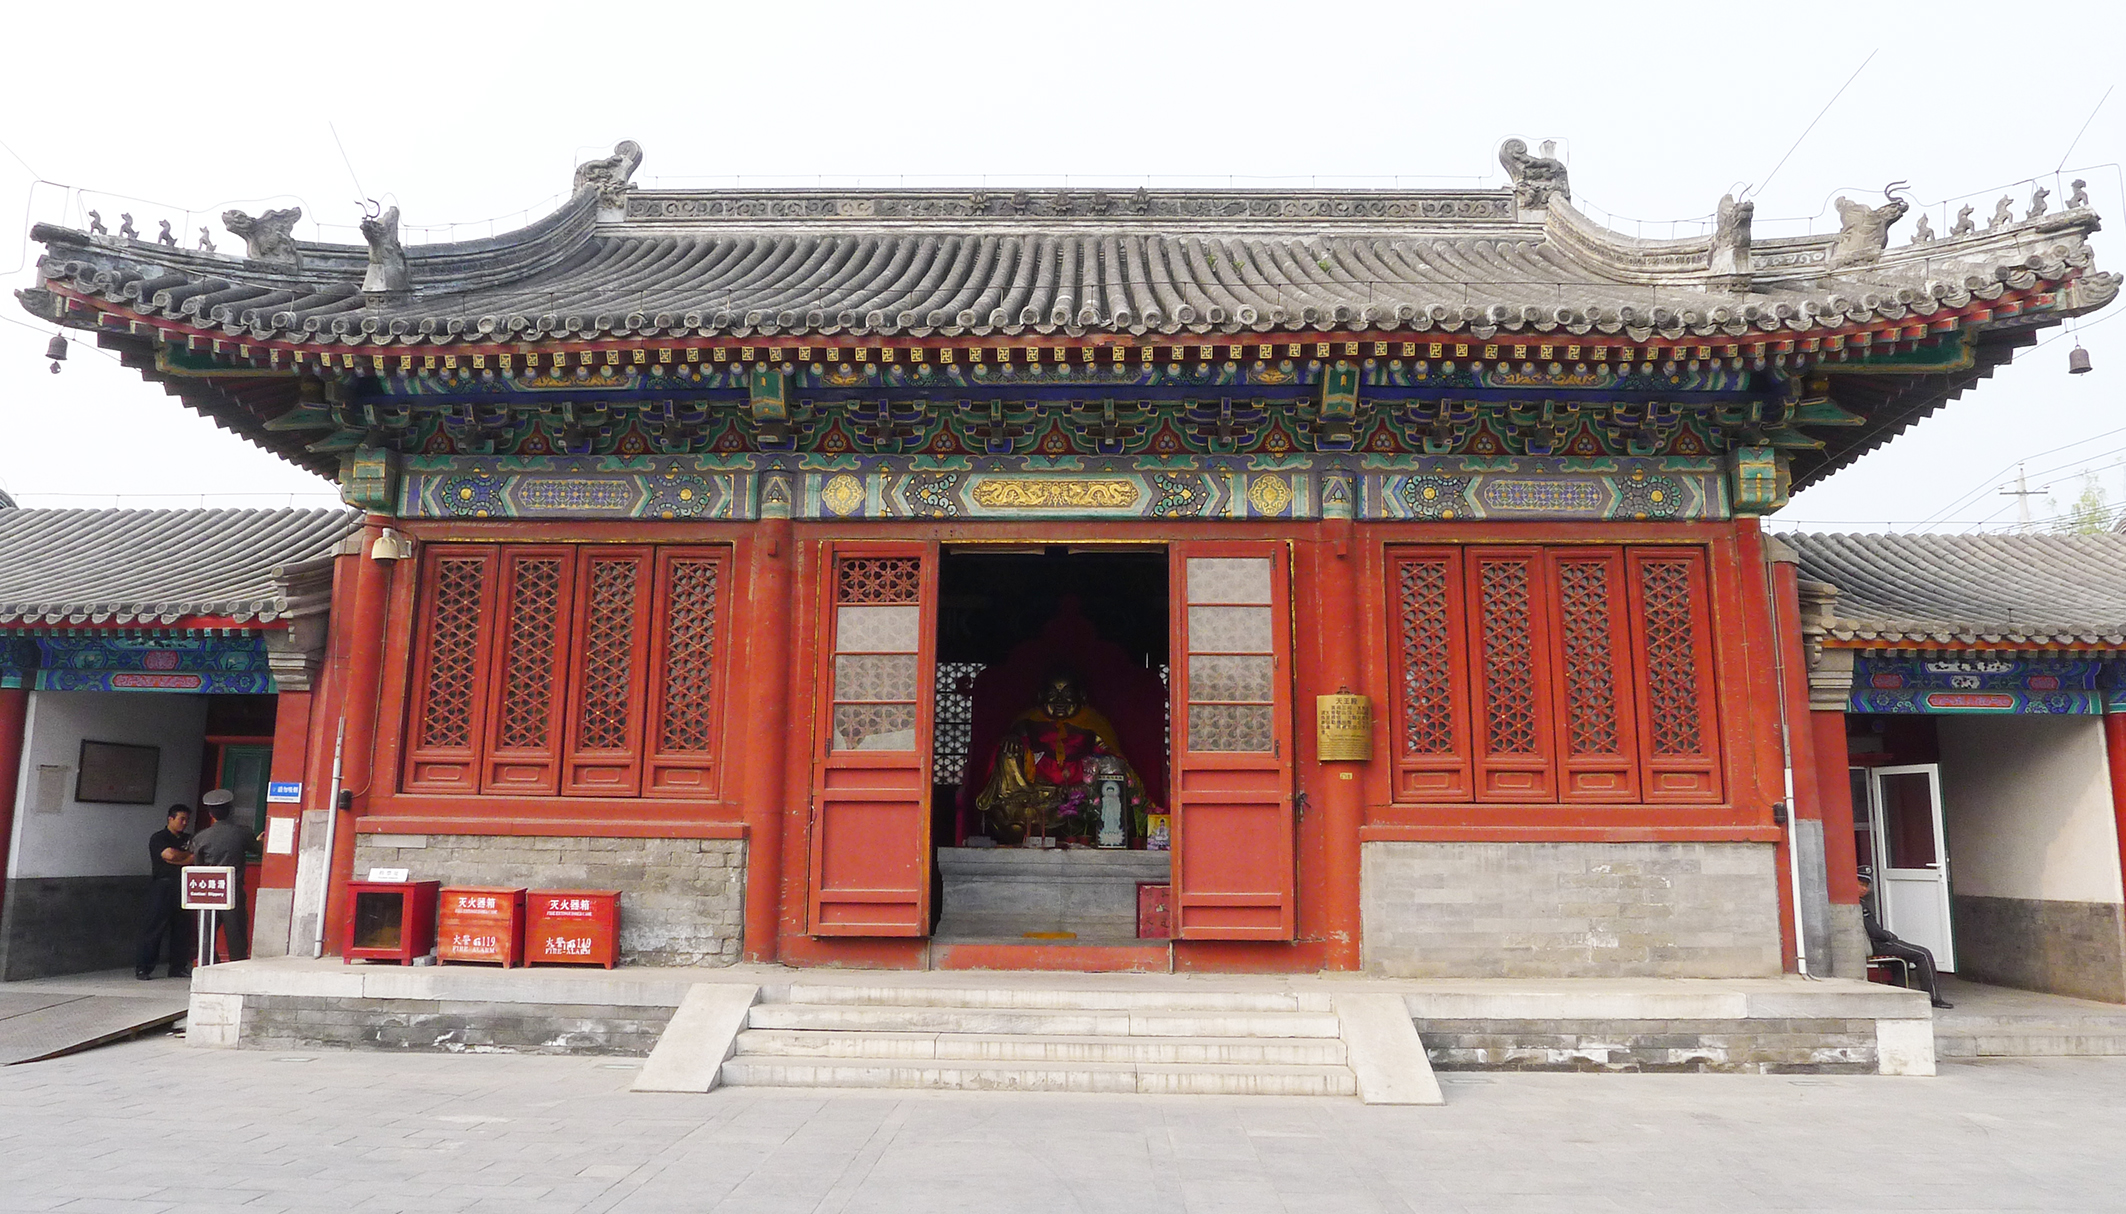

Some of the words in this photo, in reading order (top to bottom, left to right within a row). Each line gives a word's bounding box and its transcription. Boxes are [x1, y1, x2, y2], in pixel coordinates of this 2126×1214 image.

[189, 879, 226, 890] 小心路滑
[458, 897, 496, 909] 灭火器箱
[549, 899, 590, 911] 灭火器箱
[453, 934, 471, 946] 火警
[482, 936, 496, 947] 119
